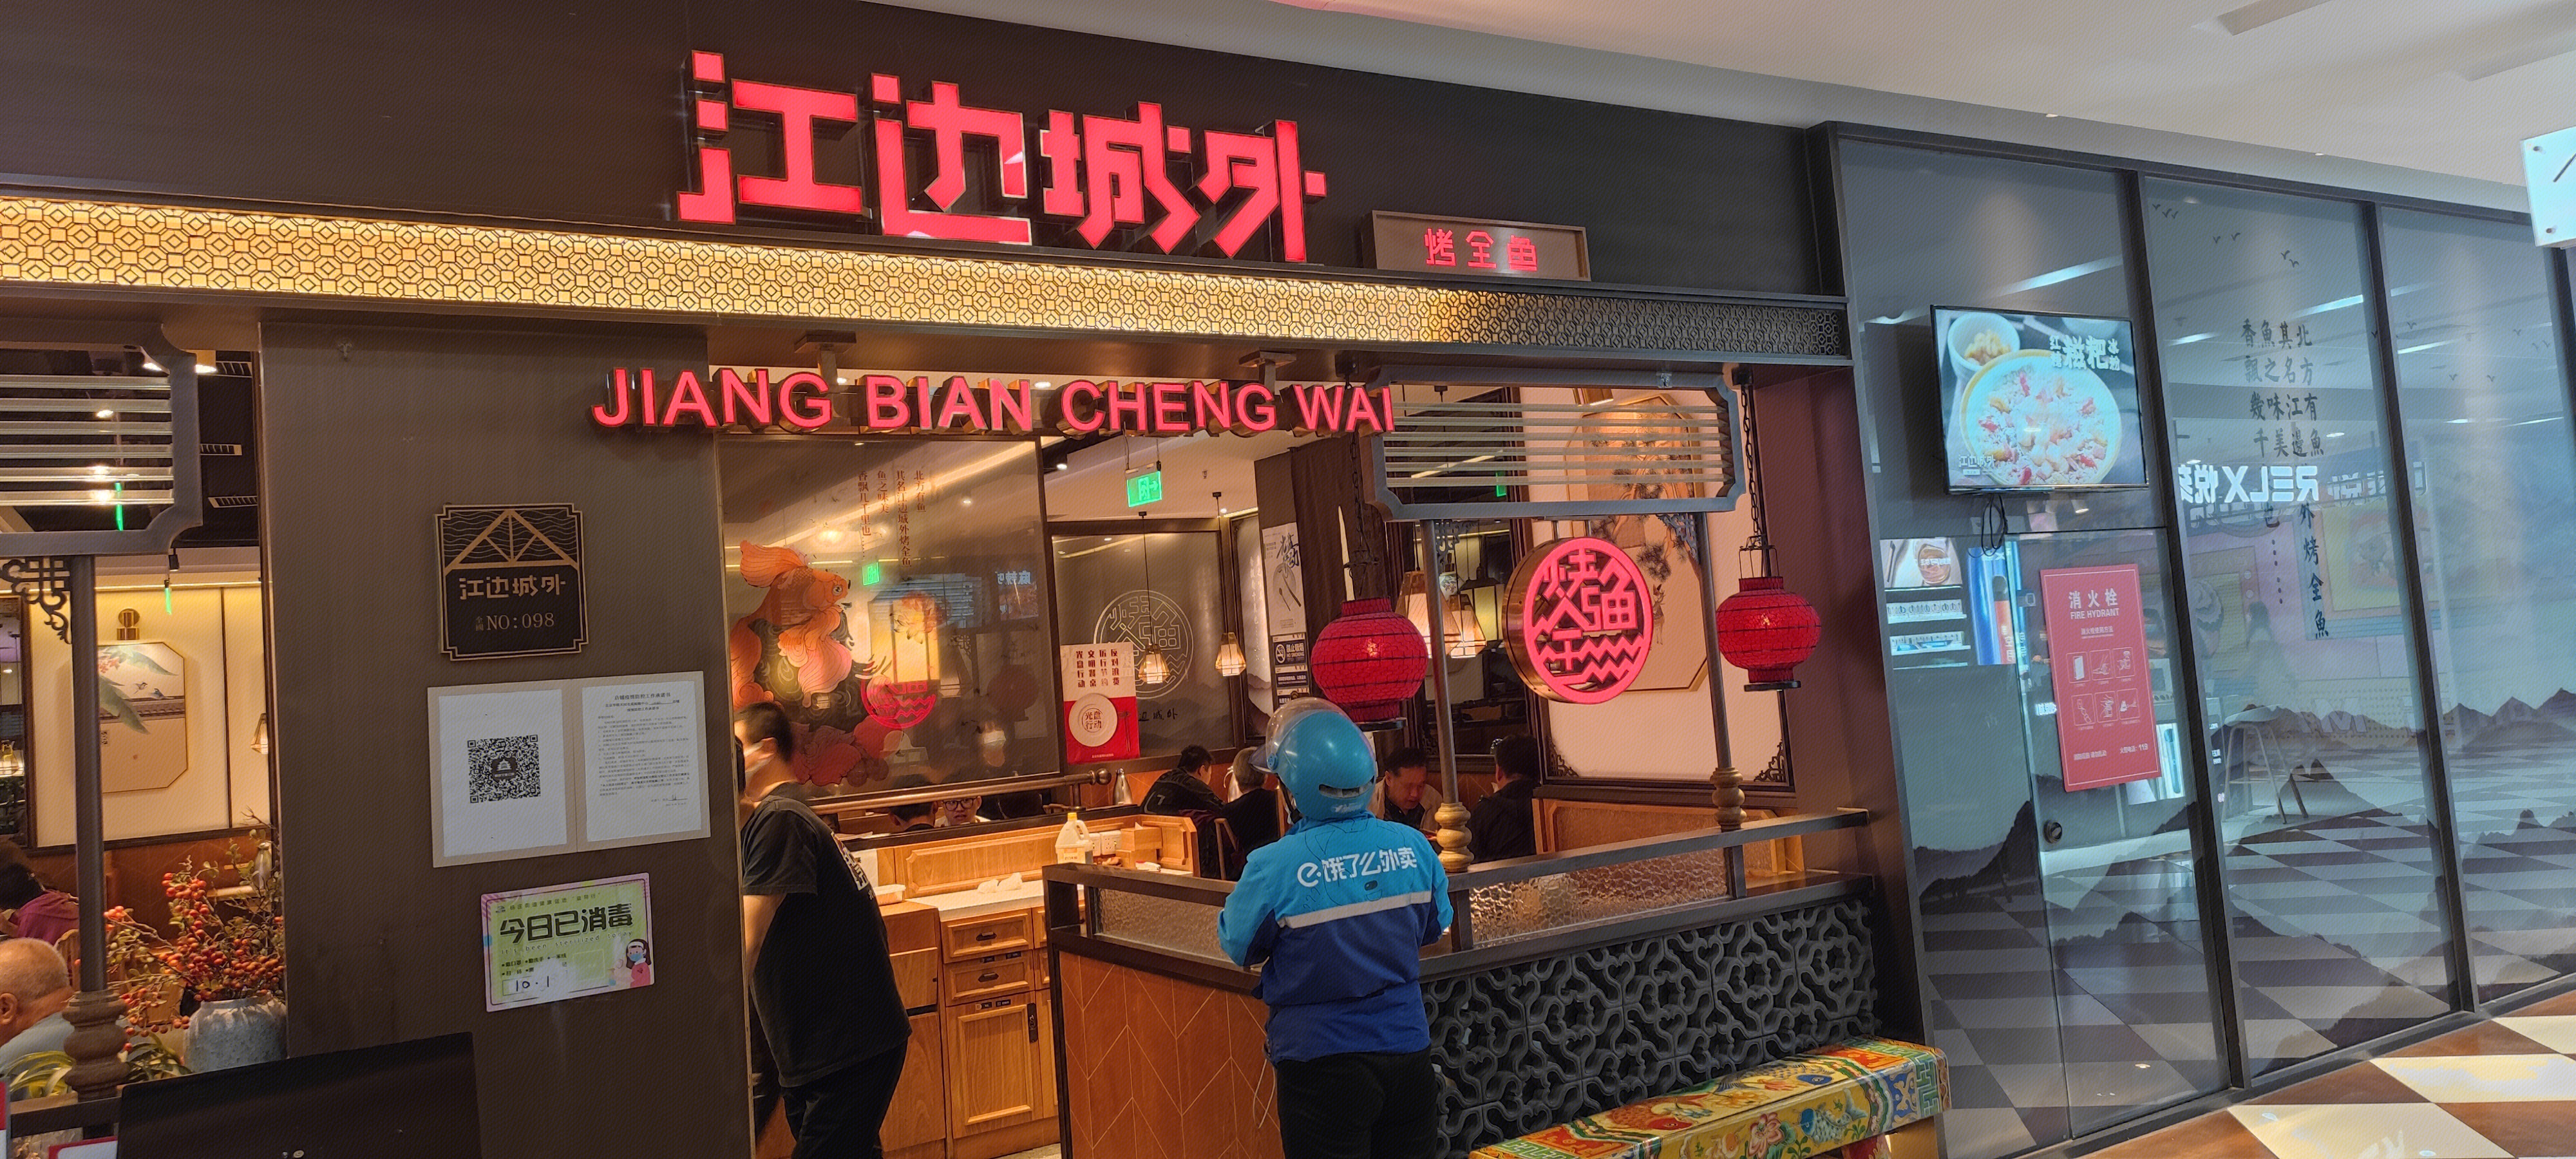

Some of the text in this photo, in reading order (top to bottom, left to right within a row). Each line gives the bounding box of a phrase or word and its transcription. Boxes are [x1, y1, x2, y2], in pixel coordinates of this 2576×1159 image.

[677, 50, 1327, 263] 江边城外
[1424, 227, 1538, 272] 烤全鱼
[591, 367, 1395, 433] JIANG BIAN CHENG WAI
[877, 471, 889, 514] 鱼之味美
[914, 470, 926, 513] 北方有鱼
[2278, 321, 2329, 639] 其名江邊外烤全魚
[896, 470, 911, 567] 其名江边城外烤全鱼
[459, 573, 567, 600] 江边城外
[2068, 588, 2118, 609] 消火栓
[2070, 608, 2119, 619] FIRE HYDRANT
[1075, 650, 1085, 688] 光盘行动
[1110, 648, 1120, 685] 反对浪费
[1084, 710, 1101, 720] 光盘
[1085, 720, 1102, 730] 行动
[2138, 742, 2149, 751] 119
[1321, 846, 1417, 883] 饿了么外卖
[500, 903, 633, 944] 今日已消毒
[555, 935, 600, 947] sterilized
